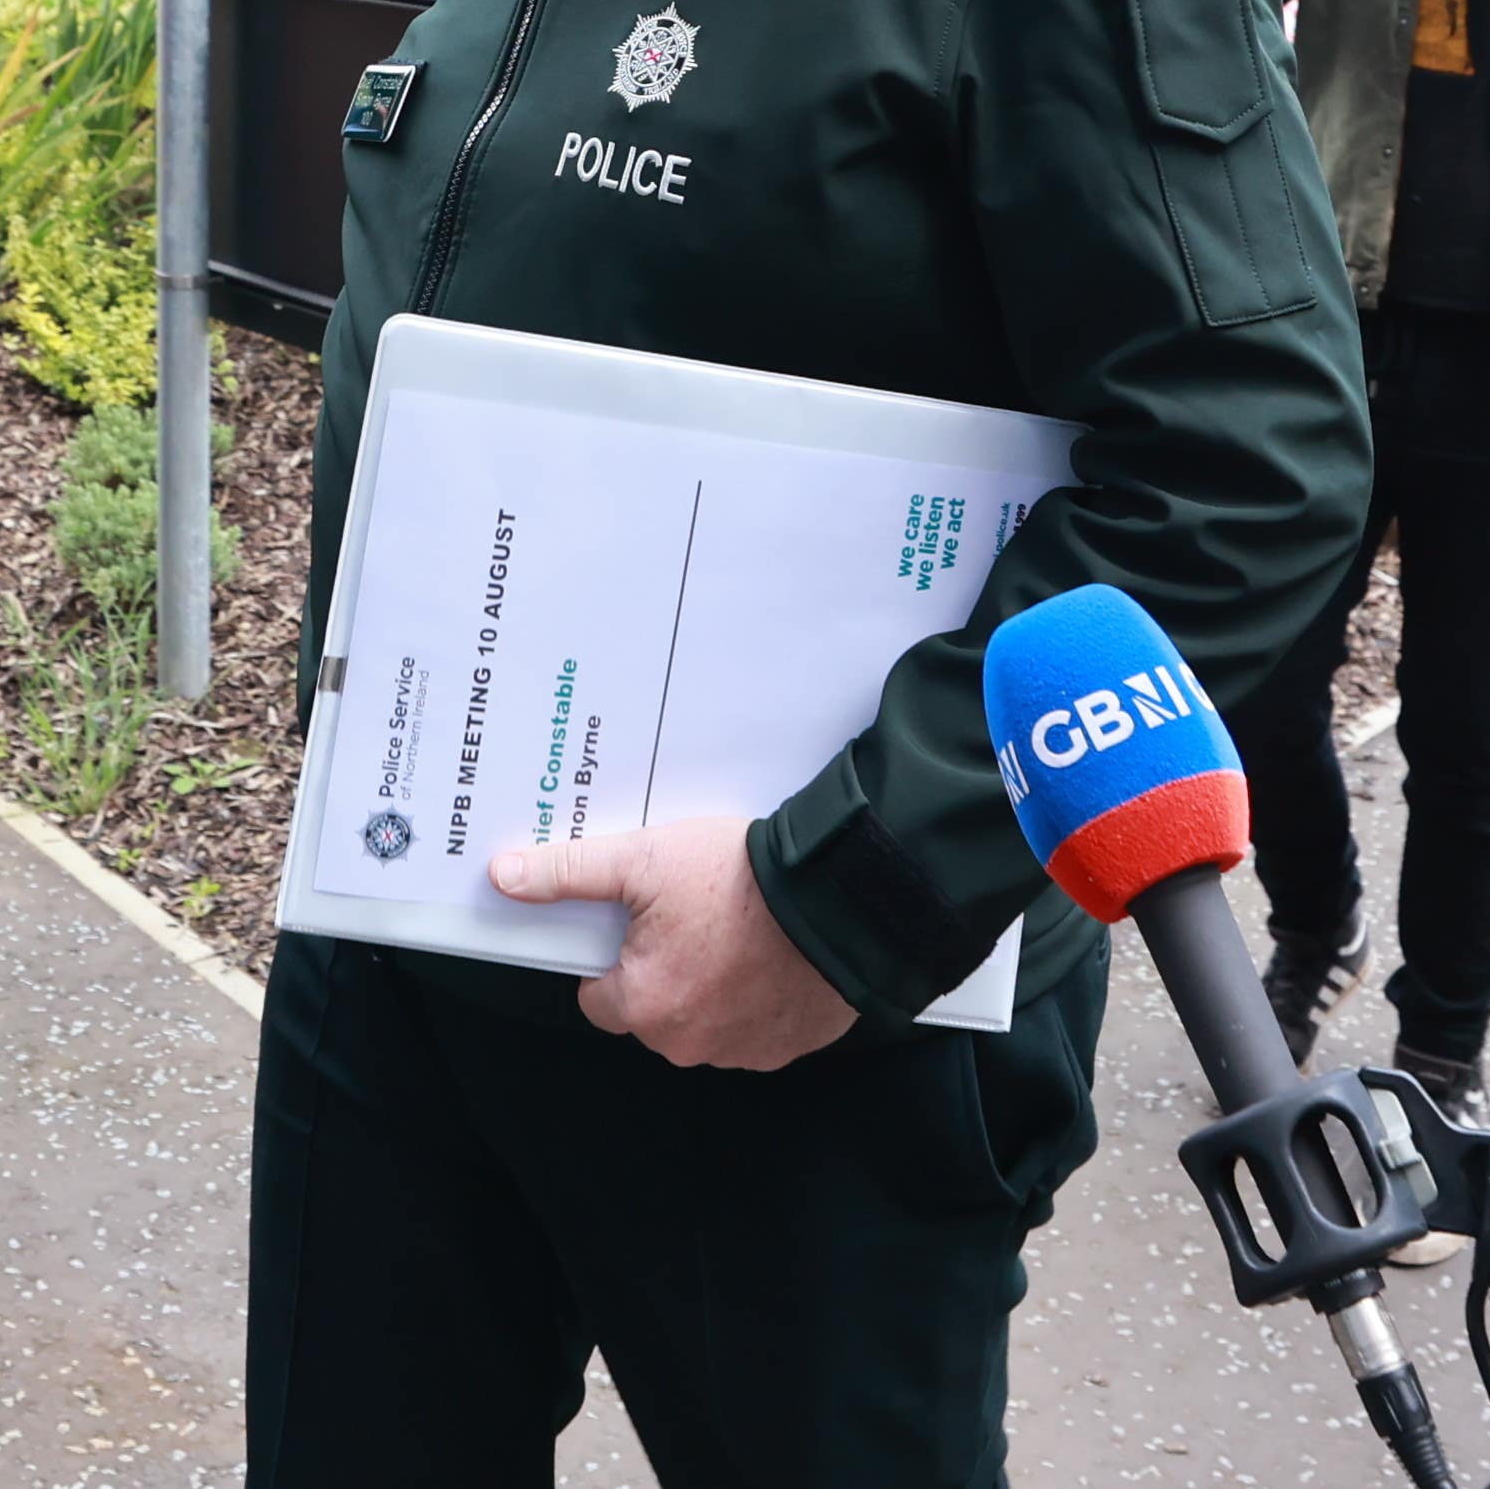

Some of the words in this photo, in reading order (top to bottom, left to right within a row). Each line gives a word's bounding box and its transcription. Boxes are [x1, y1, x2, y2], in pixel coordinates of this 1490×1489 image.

[554, 132, 692, 205] POLICE
[905, 493, 924, 541] care
[918, 496, 945, 555] listen
[947, 497, 965, 533] act
[483, 508, 516, 620] AUGUST
[898, 546, 915, 577] we
[916, 559, 933, 591] we
[941, 538, 958, 569] we
[477, 628, 498, 656] 10
[389, 656, 415, 730] Service
[413, 669, 429, 718] Ireland
[402, 721, 422, 782] Northern
[457, 667, 491, 785] MEETING
[539, 658, 577, 792] Constable
[574, 715, 601, 786] Byrne
[378, 736, 403, 798] Police
[400, 785, 412, 801] of
[446, 795, 472, 856] NIPB
